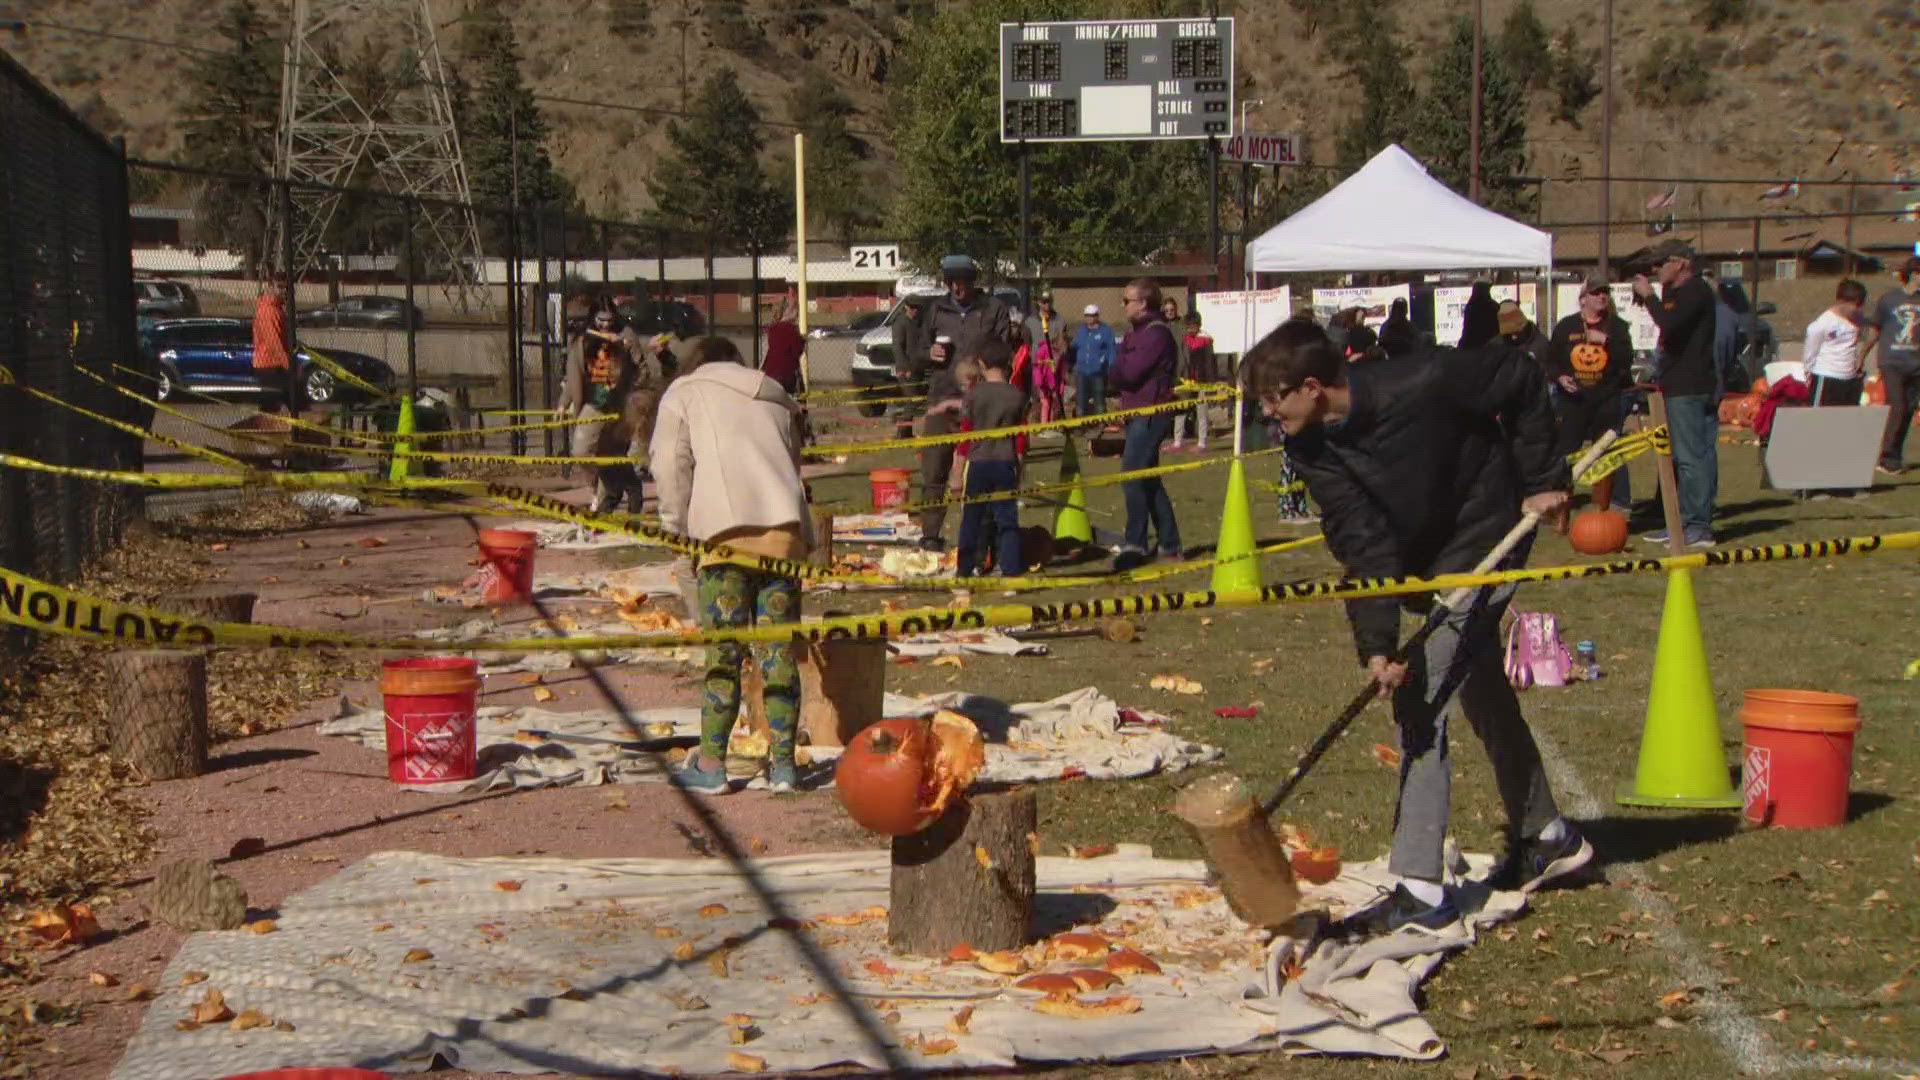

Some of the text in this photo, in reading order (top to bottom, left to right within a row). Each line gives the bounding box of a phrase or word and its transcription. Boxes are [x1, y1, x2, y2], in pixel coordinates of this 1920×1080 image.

[1023, 27, 1049, 41] HOME
[1179, 22, 1216, 37] GUESTS
[1028, 83, 1052, 98] TIME
[1158, 80, 1181, 95] BALL
[1158, 100, 1193, 115] STRIKE
[1159, 121, 1179, 135] OUT
[1227, 135, 1244, 159] 40
[1249, 136, 1296, 162] MOTEL
[854, 249, 896, 268] 211
